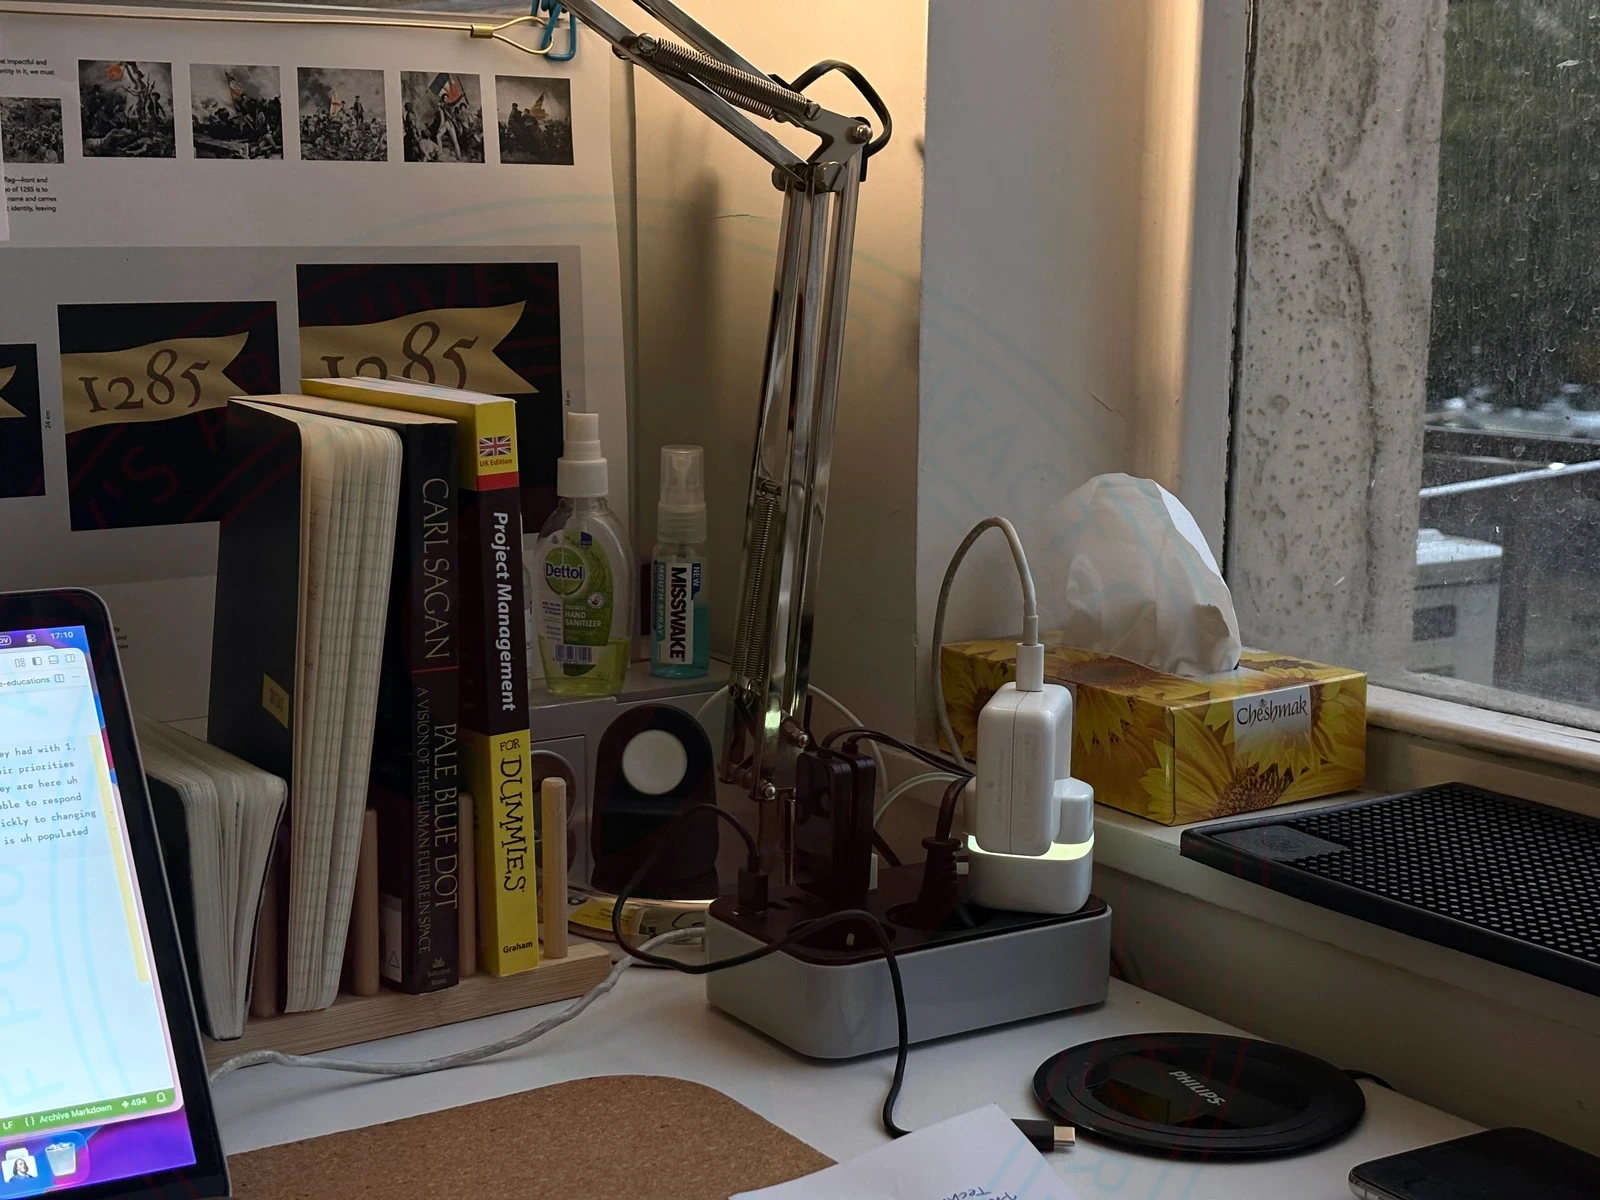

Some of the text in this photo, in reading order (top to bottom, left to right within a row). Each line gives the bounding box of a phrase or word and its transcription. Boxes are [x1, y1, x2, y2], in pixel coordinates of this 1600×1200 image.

[78, 348, 211, 413] 1285
[479, 457, 513, 467] UK Edition
[422, 478, 450, 660] CARL SAGAN
[545, 563, 583, 580] Dettol
[491, 512, 517, 711] Project Management
[565, 611, 586, 619] HAND
[657, 604, 665, 636] SPRAY
[669, 567, 687, 662] MISSWAKE
[565, 619, 602, 628] SANITIZER
[50, 631, 74, 639] 17:10
[416, 687, 429, 699] A
[1236, 694, 1309, 727] Cheshmak
[416, 700, 430, 746] VISION
[15, 746, 33, 756] had
[37, 743, 60, 753] with
[499, 738, 521, 752] FOR
[19, 760, 75, 774] priorities
[416, 749, 430, 765] OF
[38, 779, 62, 788] here
[67, 776, 78, 784] uh
[417, 766, 430, 792] THE
[25, 799, 37, 807] to
[43, 792, 82, 804] respond
[52, 809, 96, 821] changing
[417, 794, 431, 848] HUMAN
[434, 723, 458, 909] PALE BLUE DOT
[500, 755, 527, 892] DUMMIES
[4, 826, 89, 845] is uh populated
[417, 850, 431, 897] FUTURE
[417, 915, 431, 953] SPACE
[503, 940, 533, 953] Graham
[1168, 1069, 1226, 1107] PHILIPS
[3, 1097, 147, 1130] LF Archive Markdown 494
